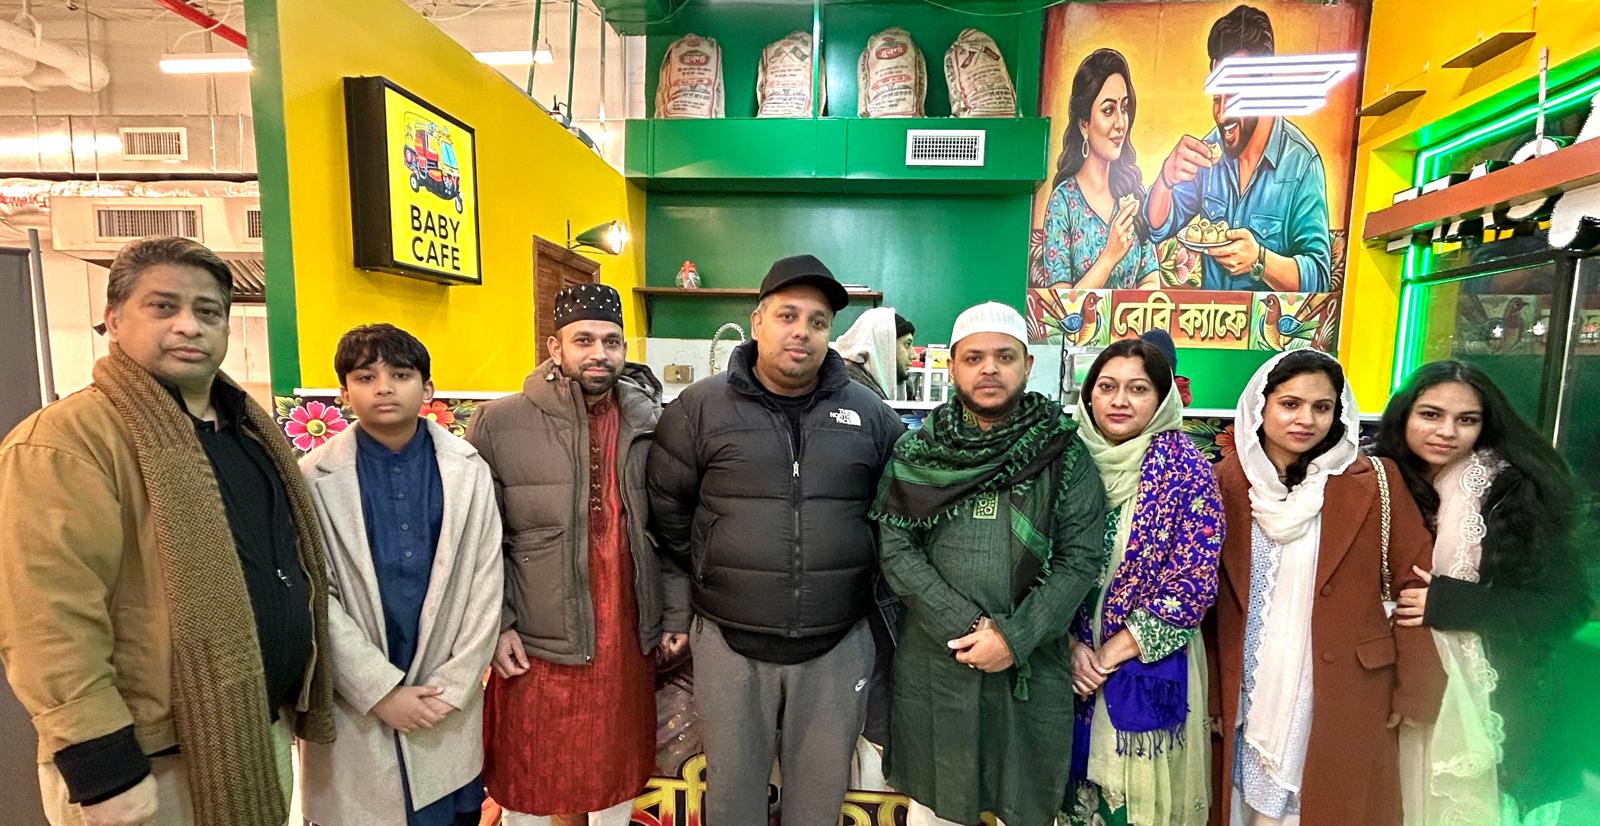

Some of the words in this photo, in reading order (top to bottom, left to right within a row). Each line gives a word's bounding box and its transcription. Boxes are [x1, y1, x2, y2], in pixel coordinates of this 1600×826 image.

[410, 204, 460, 243] BABY
[412, 236, 460, 271] CAFE
[1114, 291, 1175, 336] বেবি
[1178, 300, 1247, 339] ক্যাফে
